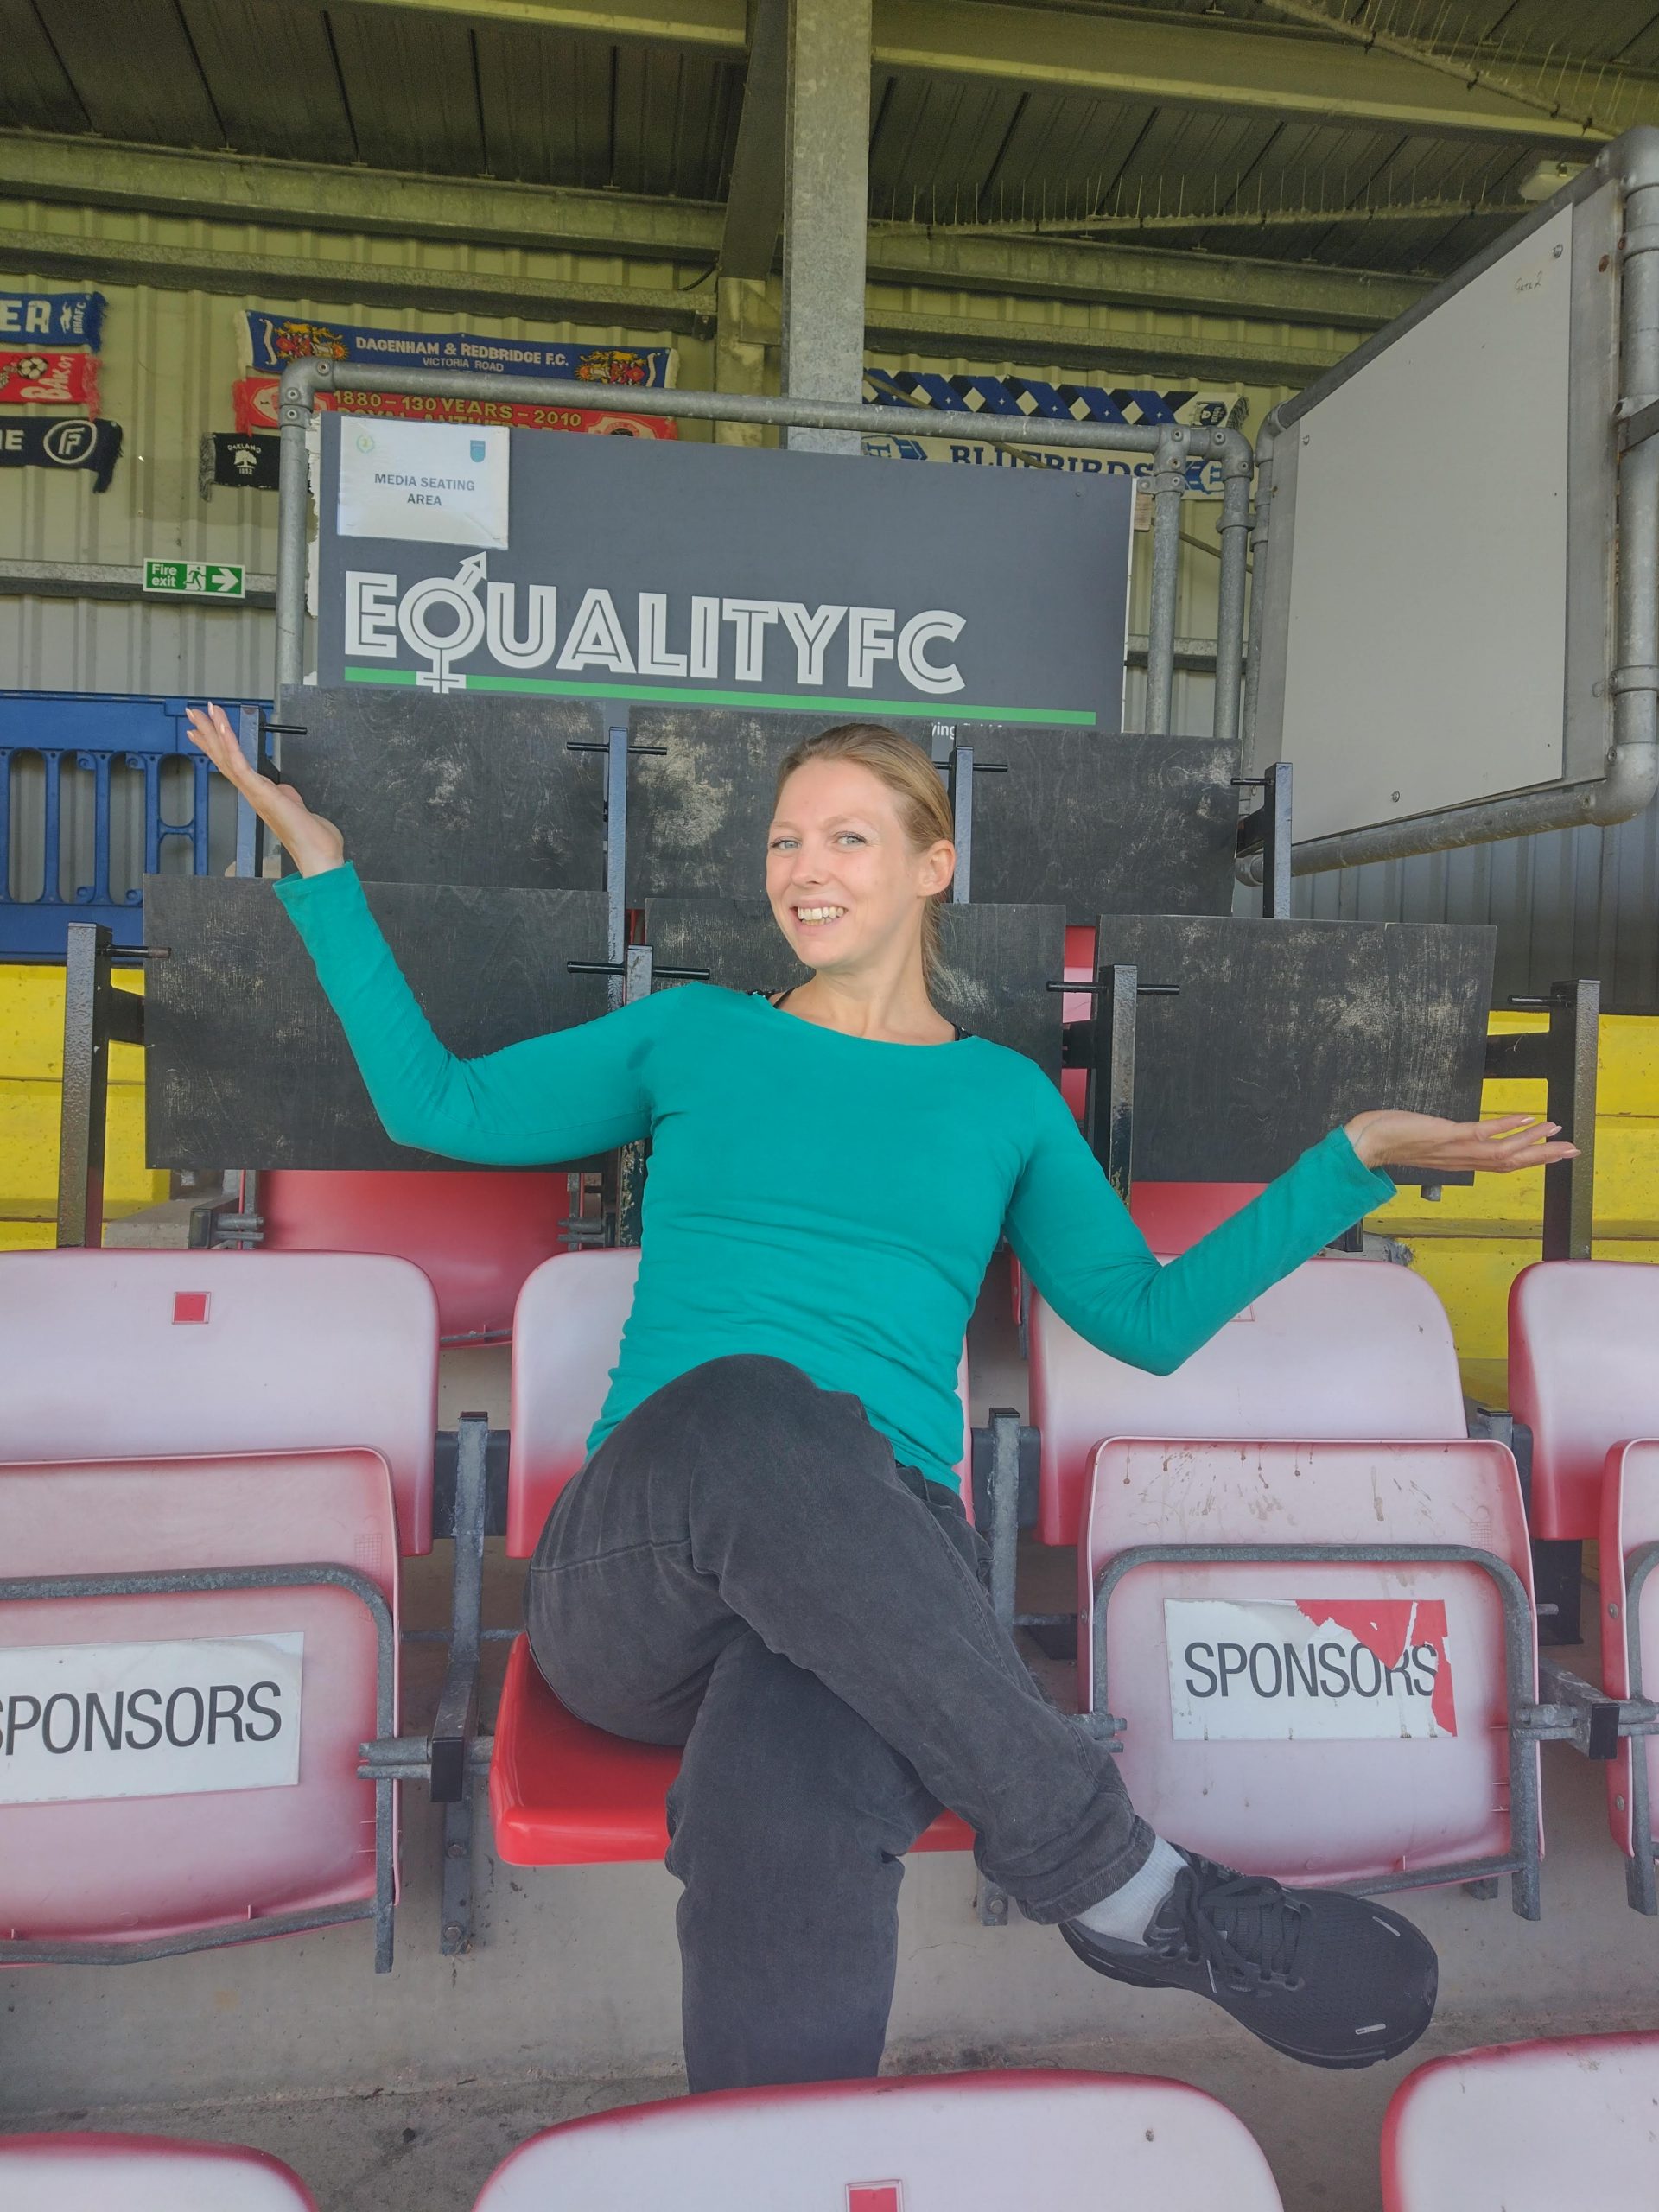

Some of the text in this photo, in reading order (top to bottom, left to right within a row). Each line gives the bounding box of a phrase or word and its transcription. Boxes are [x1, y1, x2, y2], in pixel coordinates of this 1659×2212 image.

[355, 336, 569, 367] DAGENHAM & REDBRIDGE F.C.
[422, 357, 505, 372] VICTORIA ROAD
[333, 390, 382, 407] 1880
[401, 396, 437, 411] 130
[441, 397, 513, 420] YEARS
[533, 409, 582, 427] 2010
[227, 443, 262, 454] OAKLAND
[374, 473, 476, 492] MEDIA SEATING
[407, 493, 442, 506] AREA
[151, 563, 178, 575] Fire
[151, 575, 176, 588] exit
[1185, 1642, 1439, 1698] SPONSORS
[0, 1681, 283, 1756] PONSORS
